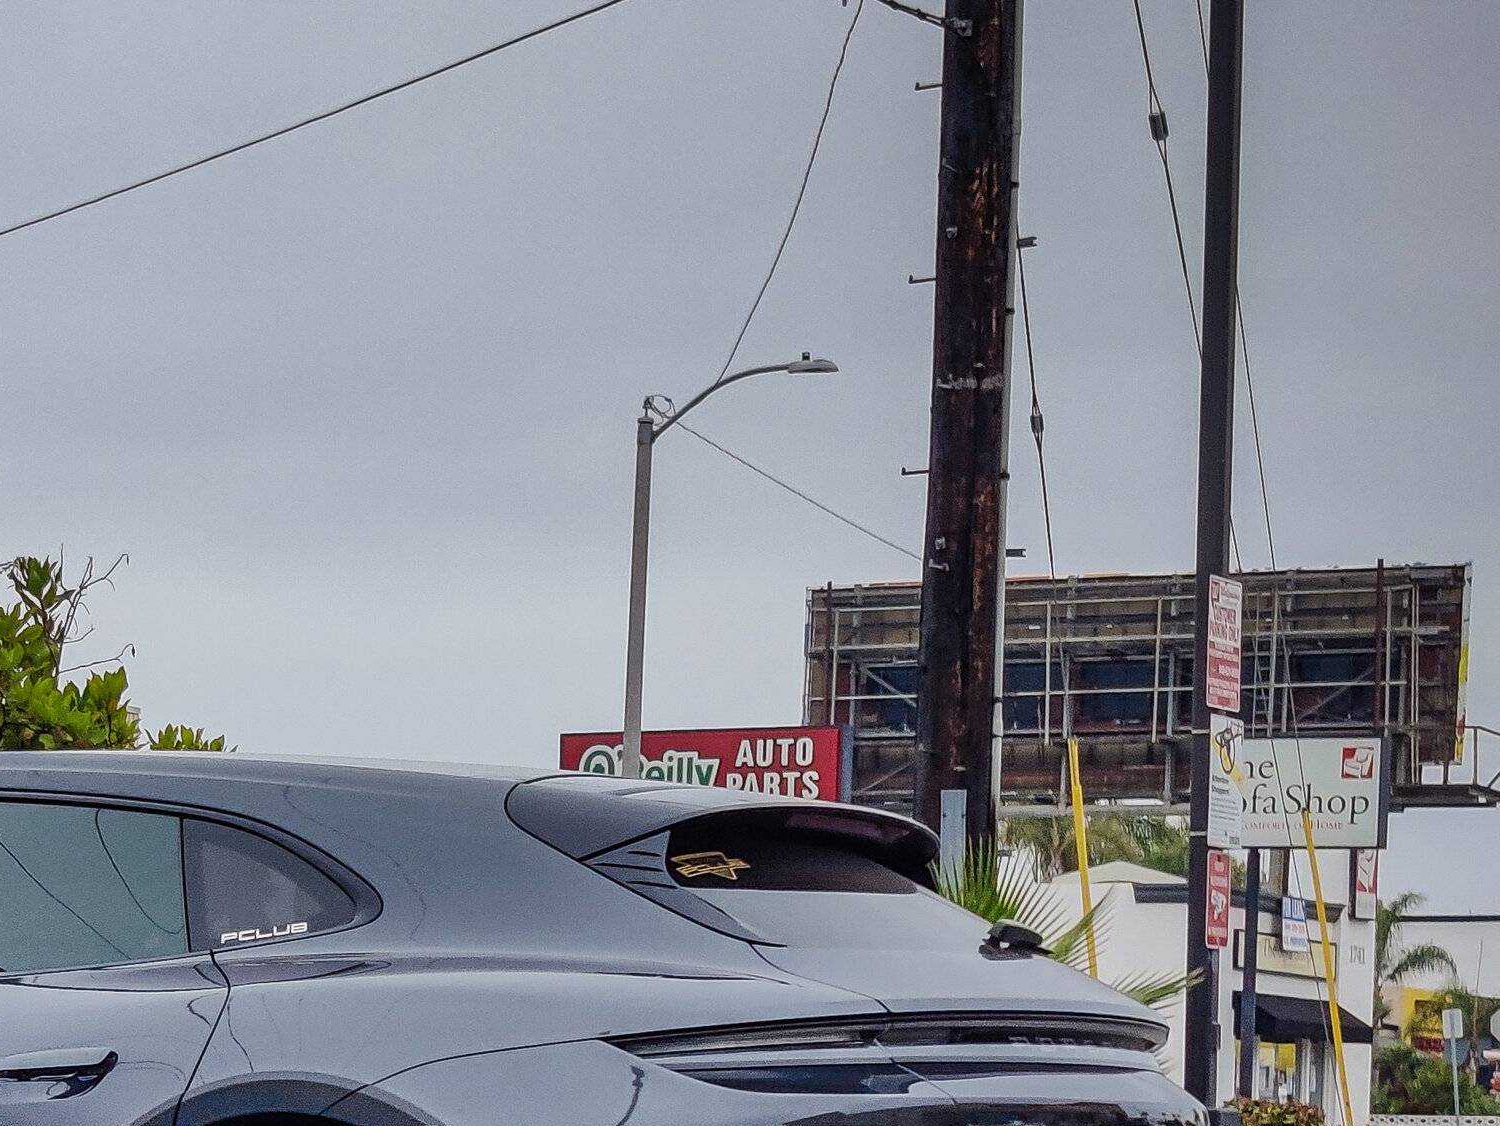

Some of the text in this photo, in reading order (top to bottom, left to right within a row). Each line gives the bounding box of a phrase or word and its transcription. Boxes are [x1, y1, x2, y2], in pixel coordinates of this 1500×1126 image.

[735, 737, 814, 768] AUTO
[726, 771, 820, 800] PARTS
[220, 922, 308, 944] PCLUB
